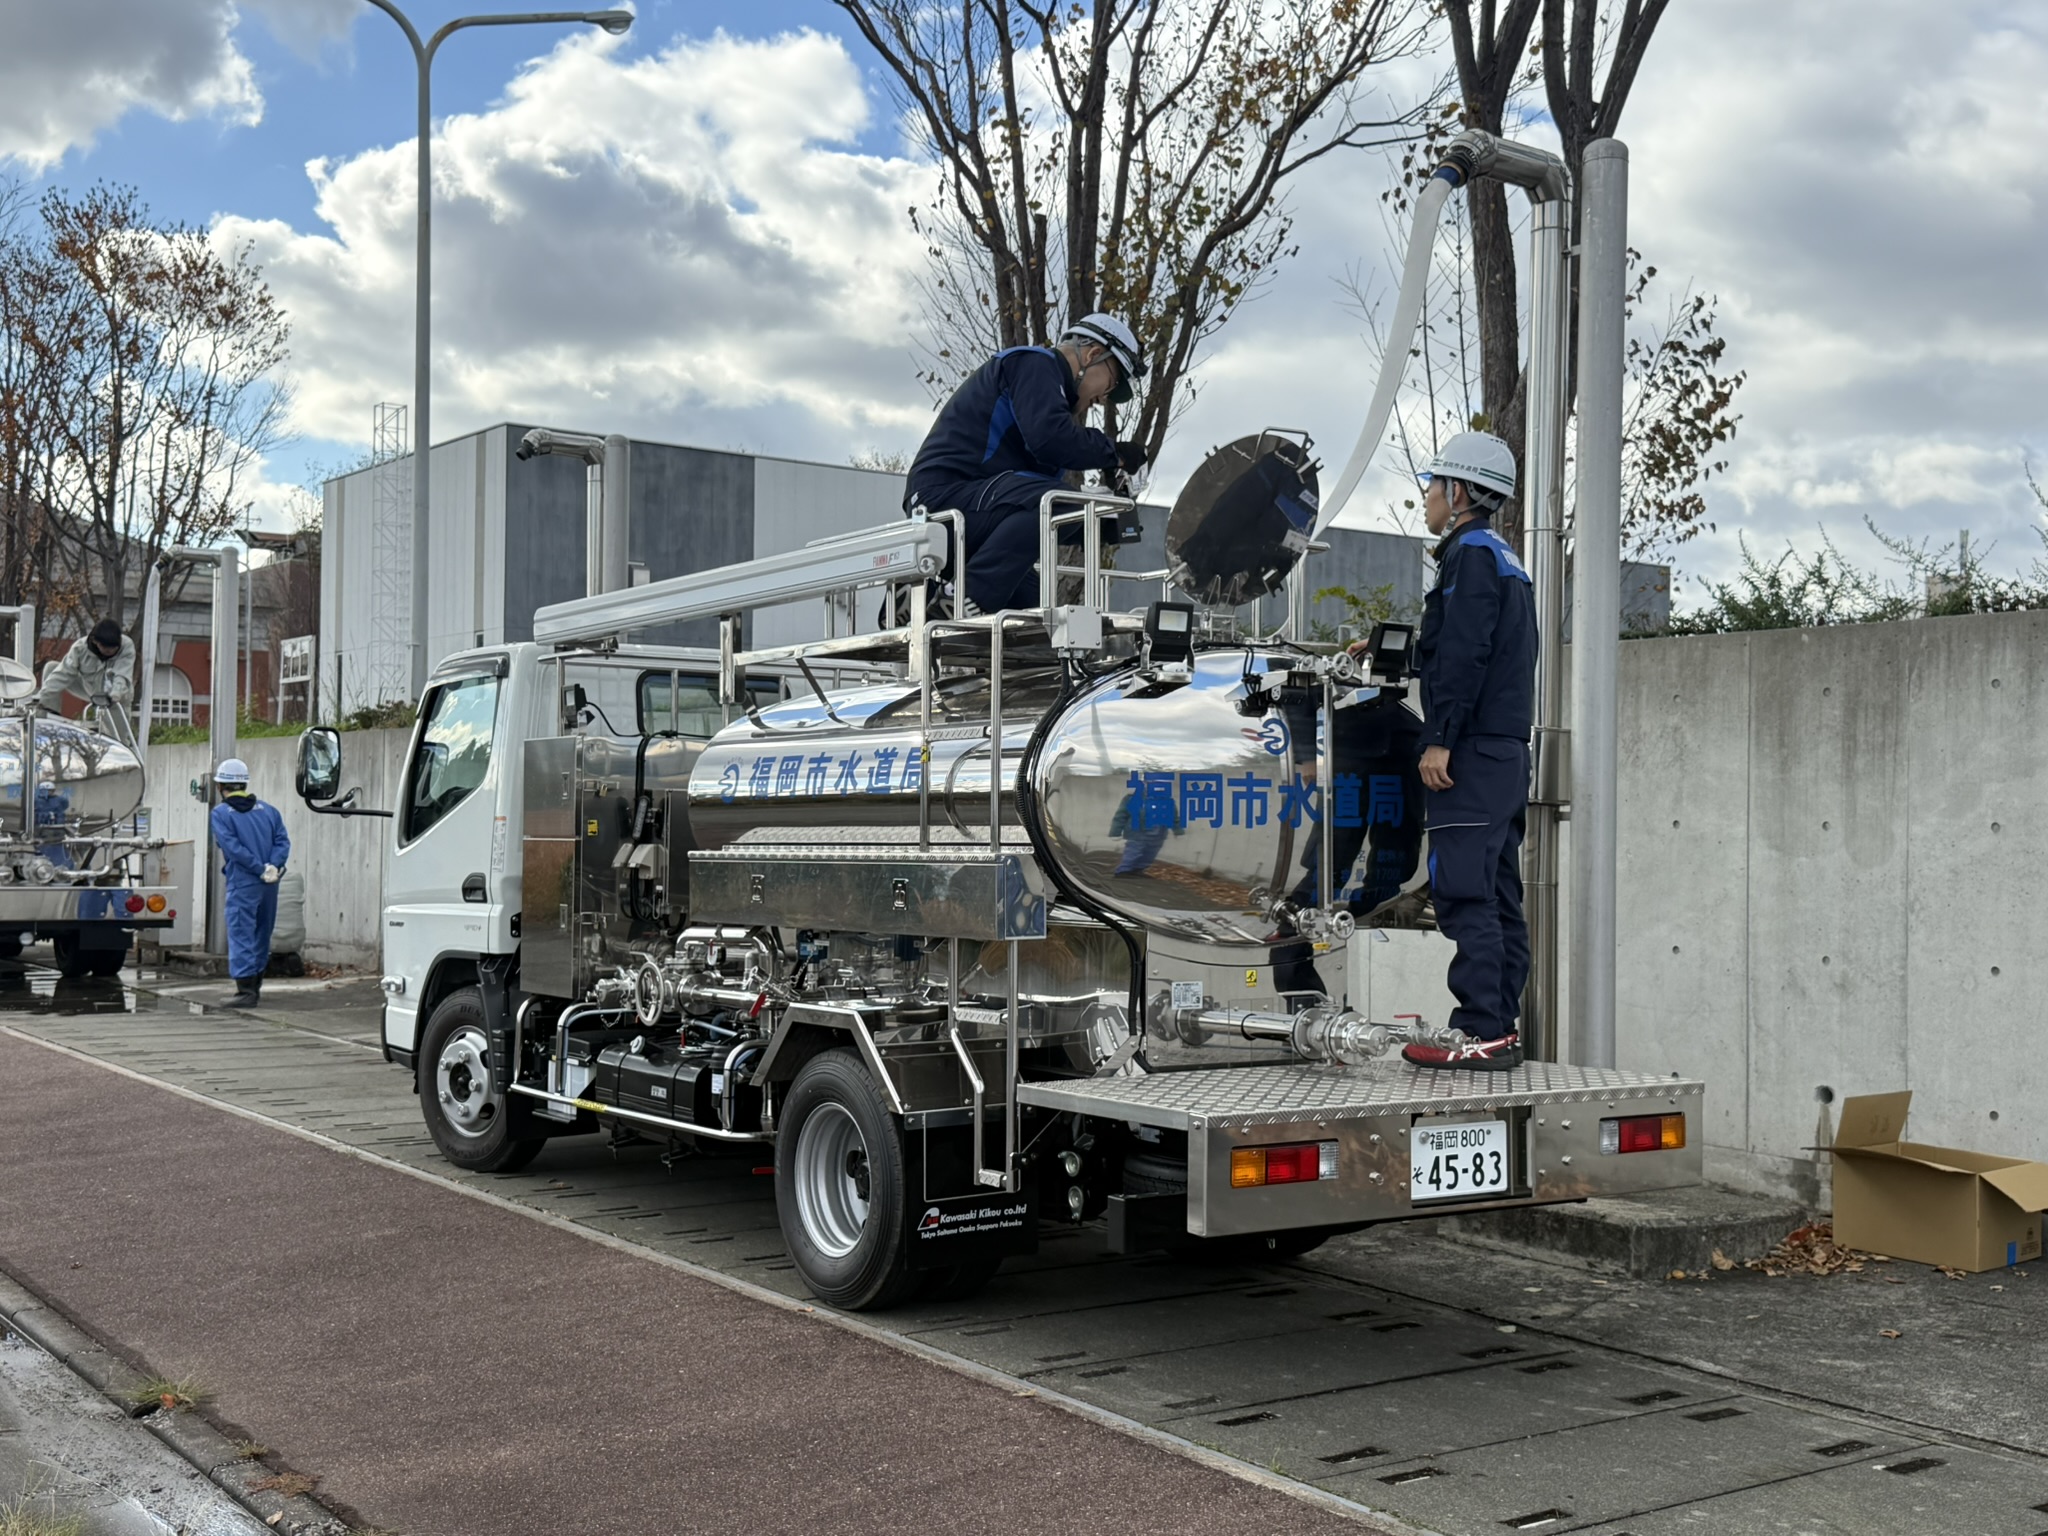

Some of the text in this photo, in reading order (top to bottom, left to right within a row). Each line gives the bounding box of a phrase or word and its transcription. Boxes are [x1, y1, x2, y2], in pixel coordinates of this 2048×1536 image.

[750, 746, 933, 800] 福岡市水道局
[1126, 770, 1404, 829] 福岡市水道局
[1430, 1128, 1485, 1150] 福岡 800
[1412, 1150, 1501, 1191] そ 45-83
[921, 1231, 936, 1239] Tokyo
[976, 1221, 998, 1231] Sapporo
[940, 1209, 977, 1224] Kawasaki
[978, 1208, 1001, 1218] Kikou
